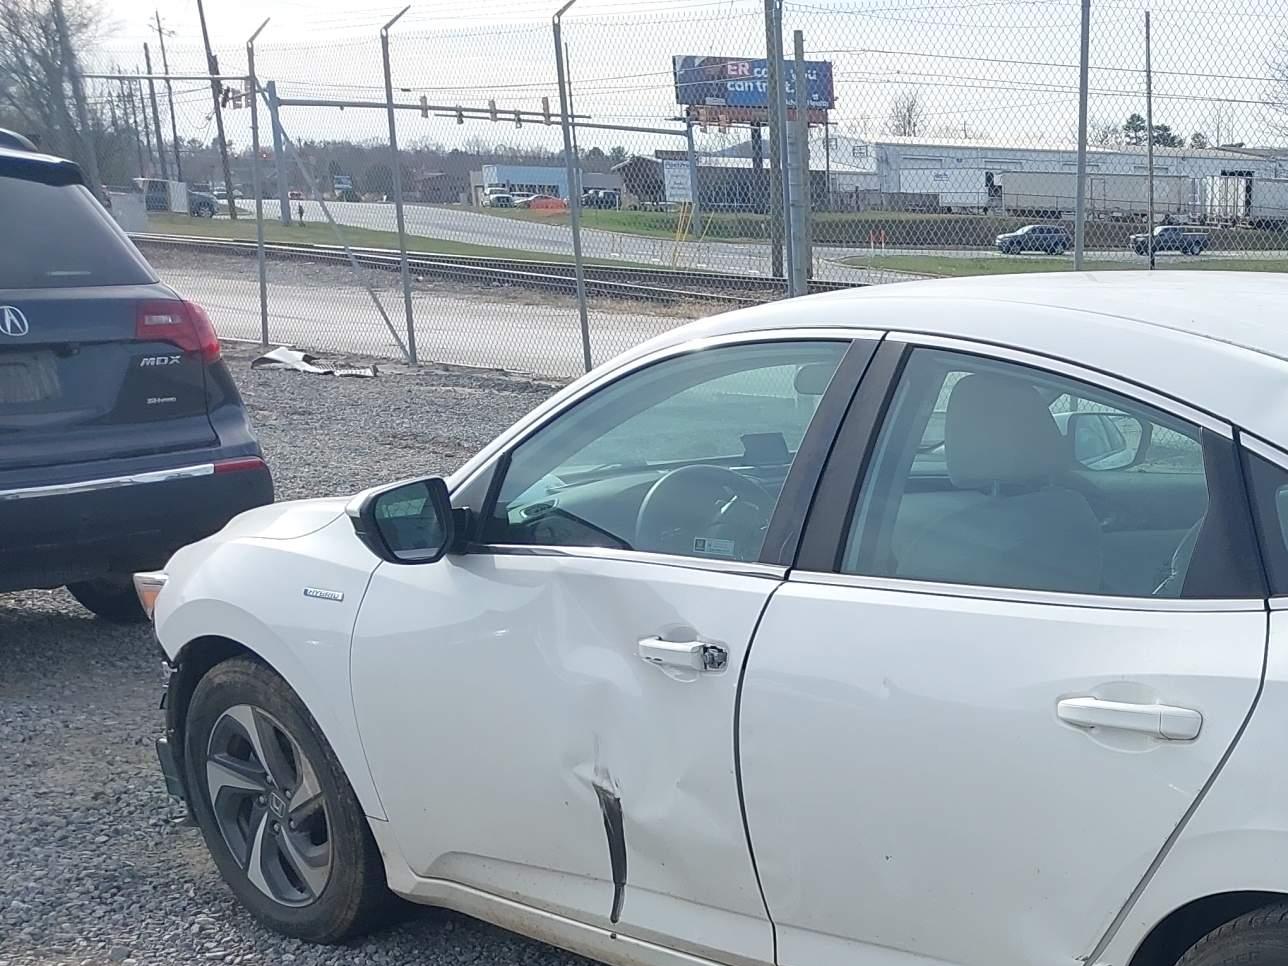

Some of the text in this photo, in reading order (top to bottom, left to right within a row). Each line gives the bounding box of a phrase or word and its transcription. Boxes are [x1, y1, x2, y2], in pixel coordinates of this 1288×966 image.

[727, 61, 750, 75] ER
[727, 79, 795, 93] can trt.
[140, 355, 181, 367] MDX
